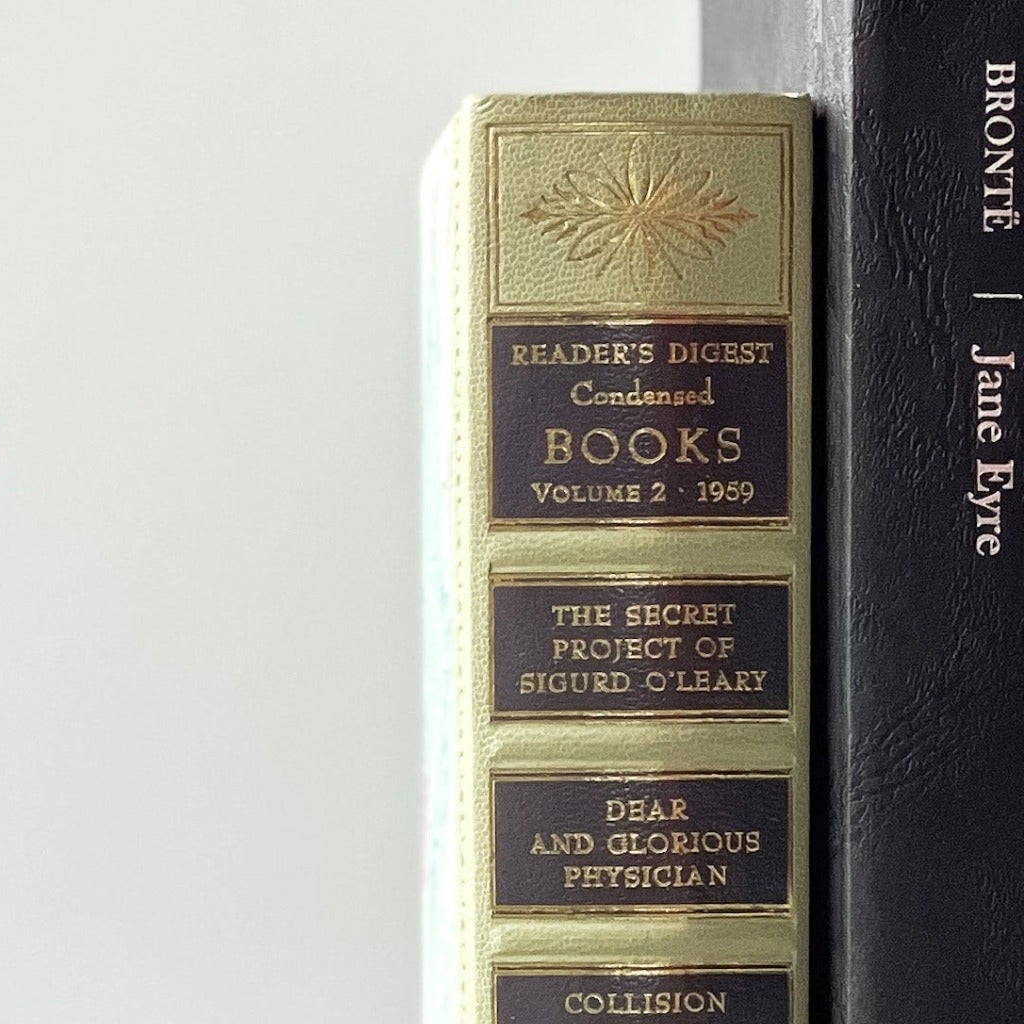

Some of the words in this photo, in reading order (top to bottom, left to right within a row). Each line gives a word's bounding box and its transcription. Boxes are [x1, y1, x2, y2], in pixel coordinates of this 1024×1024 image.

[982, 59, 1020, 234] BRONTË
[511, 342, 655, 366] READER'S
[667, 342, 774, 366] DIGEST
[570, 377, 715, 408] Condensed
[970, 344, 1016, 444] Jane
[544, 427, 743, 465] BOOKS
[531, 483, 641, 504] VOLUME
[650, 482, 667, 503] 2
[697, 481, 755, 505] 1959
[966, 459, 1015, 557] Eyre
[552, 604, 612, 627] THE
[625, 603, 736, 627] SECRET
[552, 638, 681, 662] PROJECT
[695, 637, 736, 659] OF
[519, 672, 631, 694] SIGURD
[645, 671, 768, 693] O'LEARY
[605, 798, 689, 822] DEAR
[529, 832, 594, 855] AND
[606, 831, 761, 855] GLORIOUS
[563, 865, 729, 889] PHYSICIAN
[564, 991, 727, 1015] COLLISION
